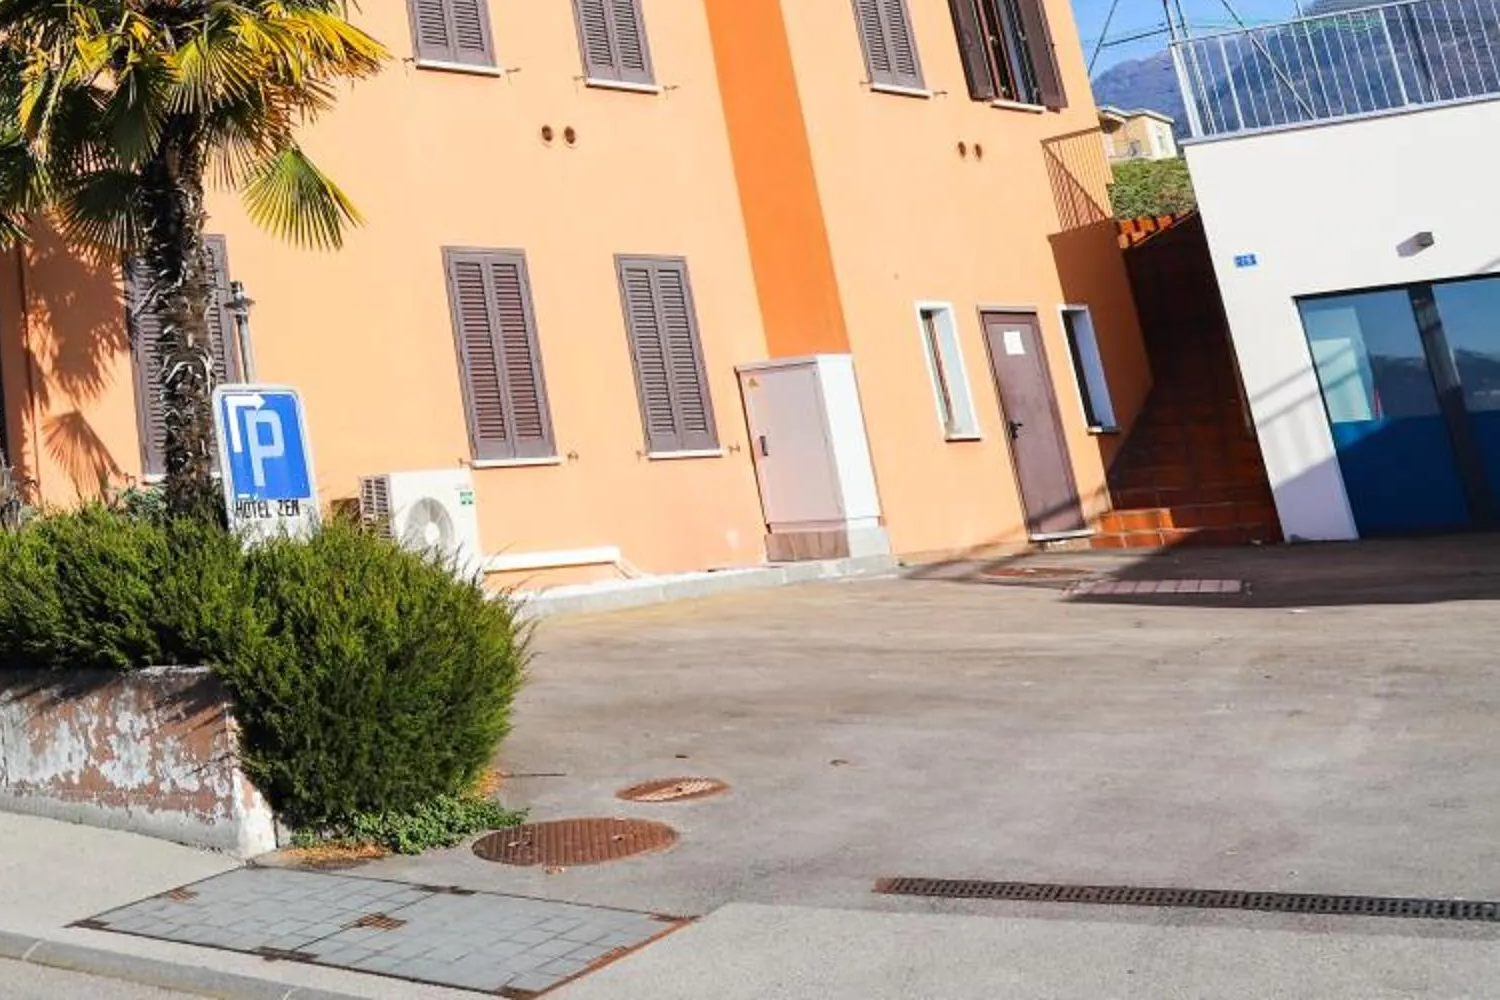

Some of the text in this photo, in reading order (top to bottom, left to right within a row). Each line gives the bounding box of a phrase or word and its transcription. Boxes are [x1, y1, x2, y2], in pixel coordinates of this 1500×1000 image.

[244, 409, 285, 488] P
[235, 499, 300, 519] HOTEL ZEN
